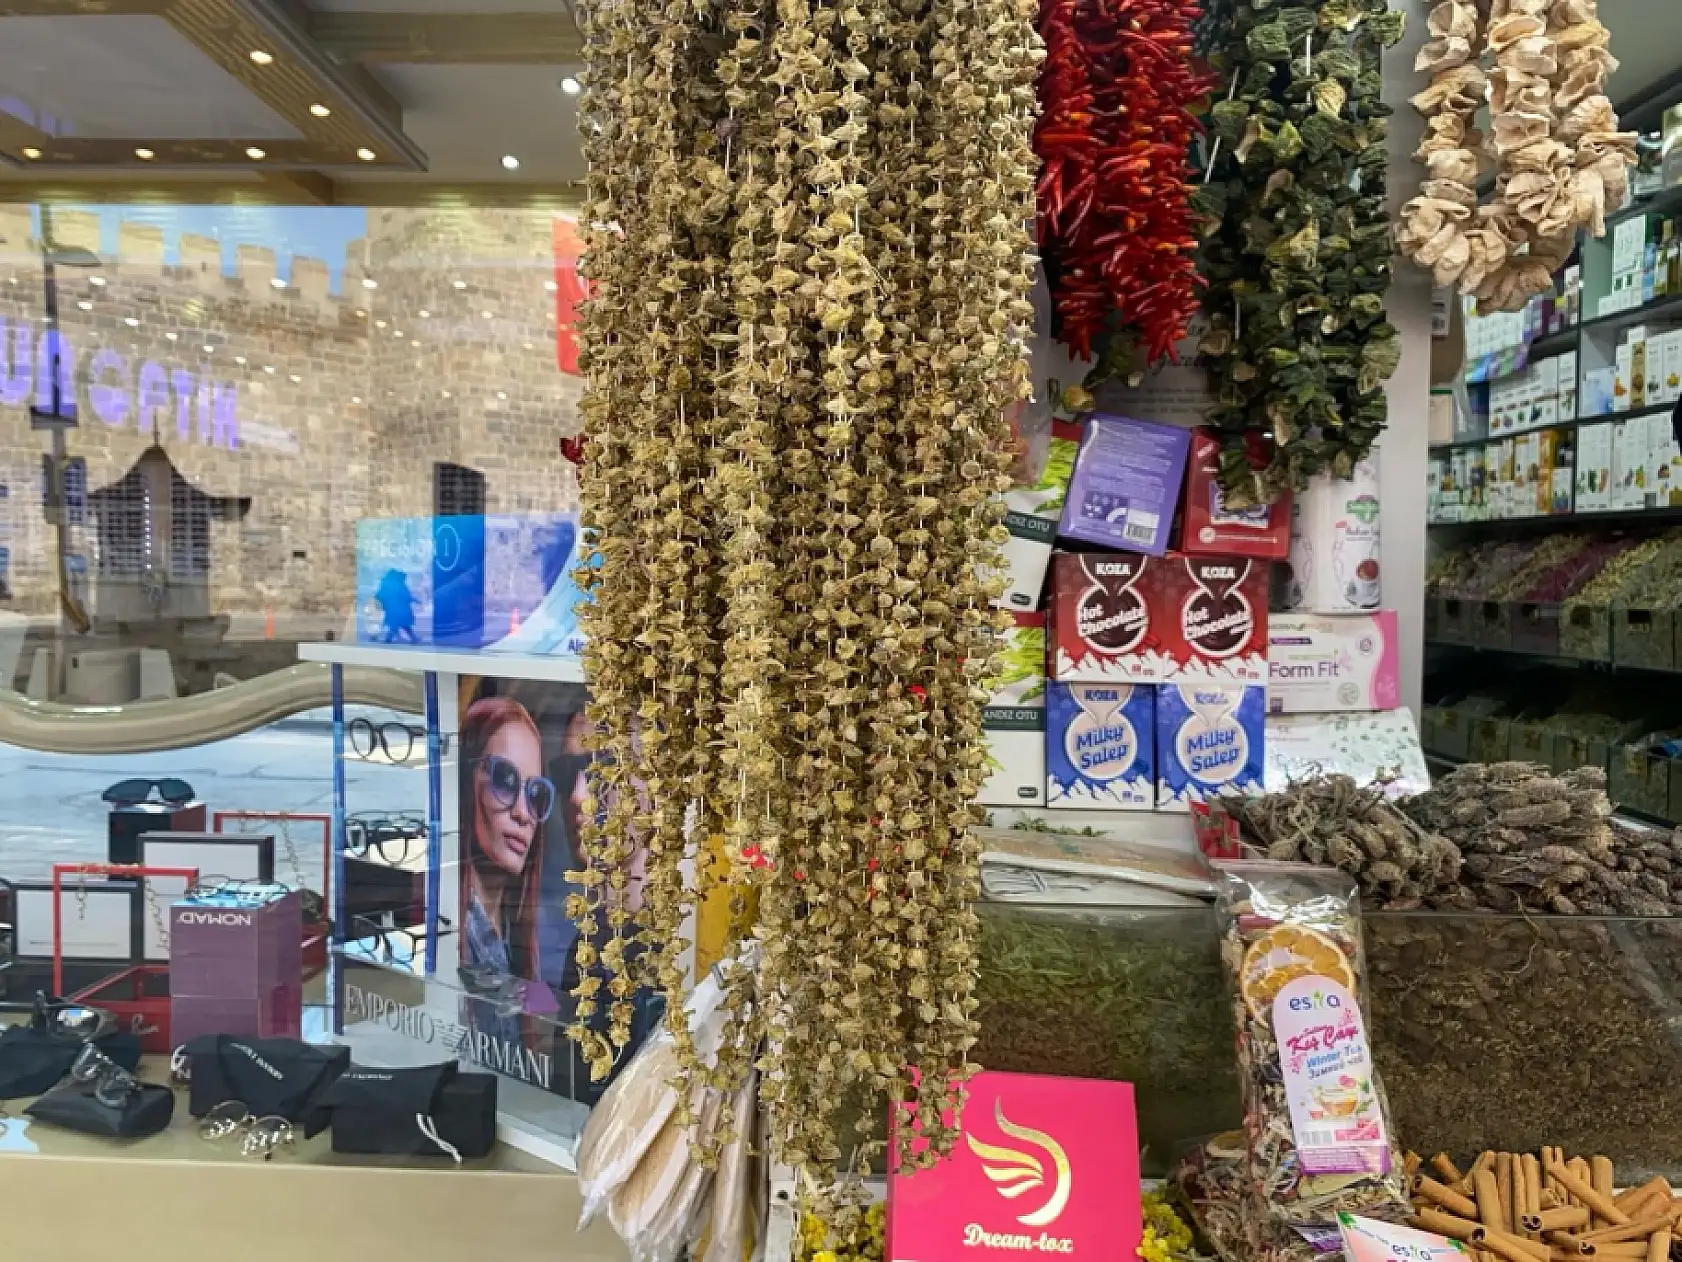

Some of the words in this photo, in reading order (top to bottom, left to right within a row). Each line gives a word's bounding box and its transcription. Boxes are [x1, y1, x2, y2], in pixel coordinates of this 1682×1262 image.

[1079, 606, 1145, 636] Chocolate
[1081, 603, 1103, 621] Hot
[1187, 606, 1210, 625] Hot
[1185, 610, 1249, 640] Chocolate
[1269, 661, 1315, 678] Form
[1318, 661, 1340, 678] Fit
[1016, 709, 1038, 720] OTU
[1077, 725, 1124, 750] Milky
[1187, 728, 1236, 753] Milky
[1080, 744, 1128, 769] Salep
[1191, 748, 1239, 772] Salep
[179, 911, 252, 926] NOMAD
[345, 983, 435, 1044] EMPORIO
[461, 1026, 551, 1088] ARMANI
[1306, 1051, 1341, 1069] Winter
[963, 1223, 1073, 1253] Dream-tox
